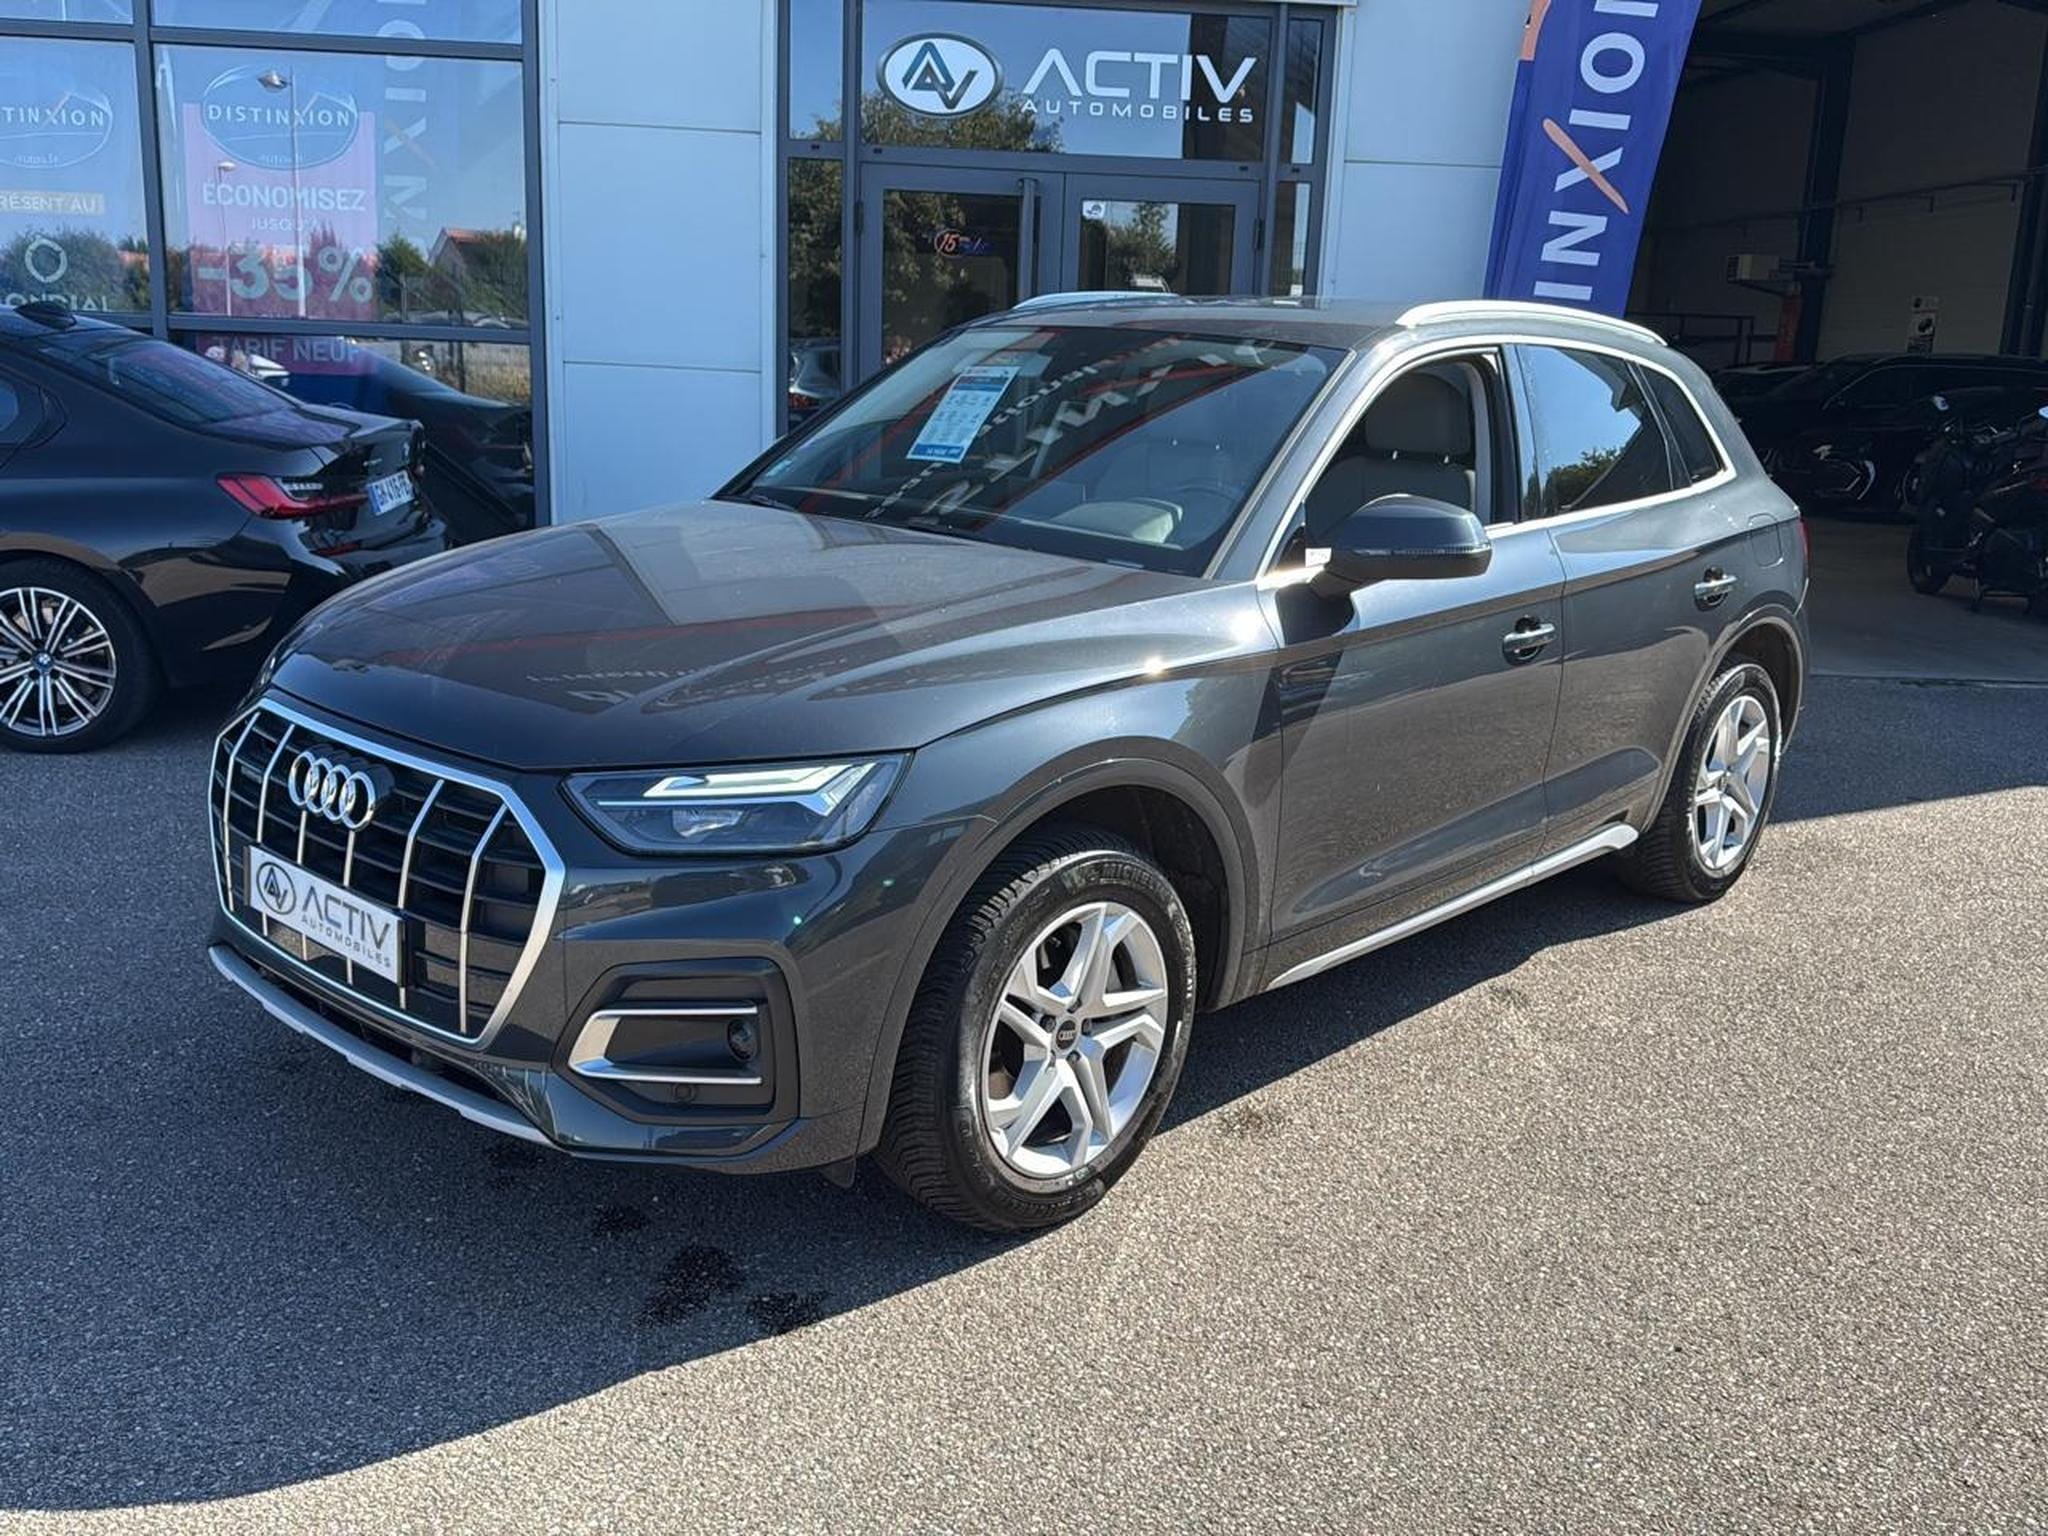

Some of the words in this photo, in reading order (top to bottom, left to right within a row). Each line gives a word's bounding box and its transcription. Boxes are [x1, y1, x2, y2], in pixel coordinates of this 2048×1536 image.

[1022, 48, 1257, 104] ACTIV
[208, 104, 350, 127] DISTINXION
[1021, 98, 1254, 123] AUTOMOBILES
[212, 334, 286, 360] TARIF
[302, 885, 391, 950] ACTIV
[300, 914, 392, 969] AUTOMOBILES
